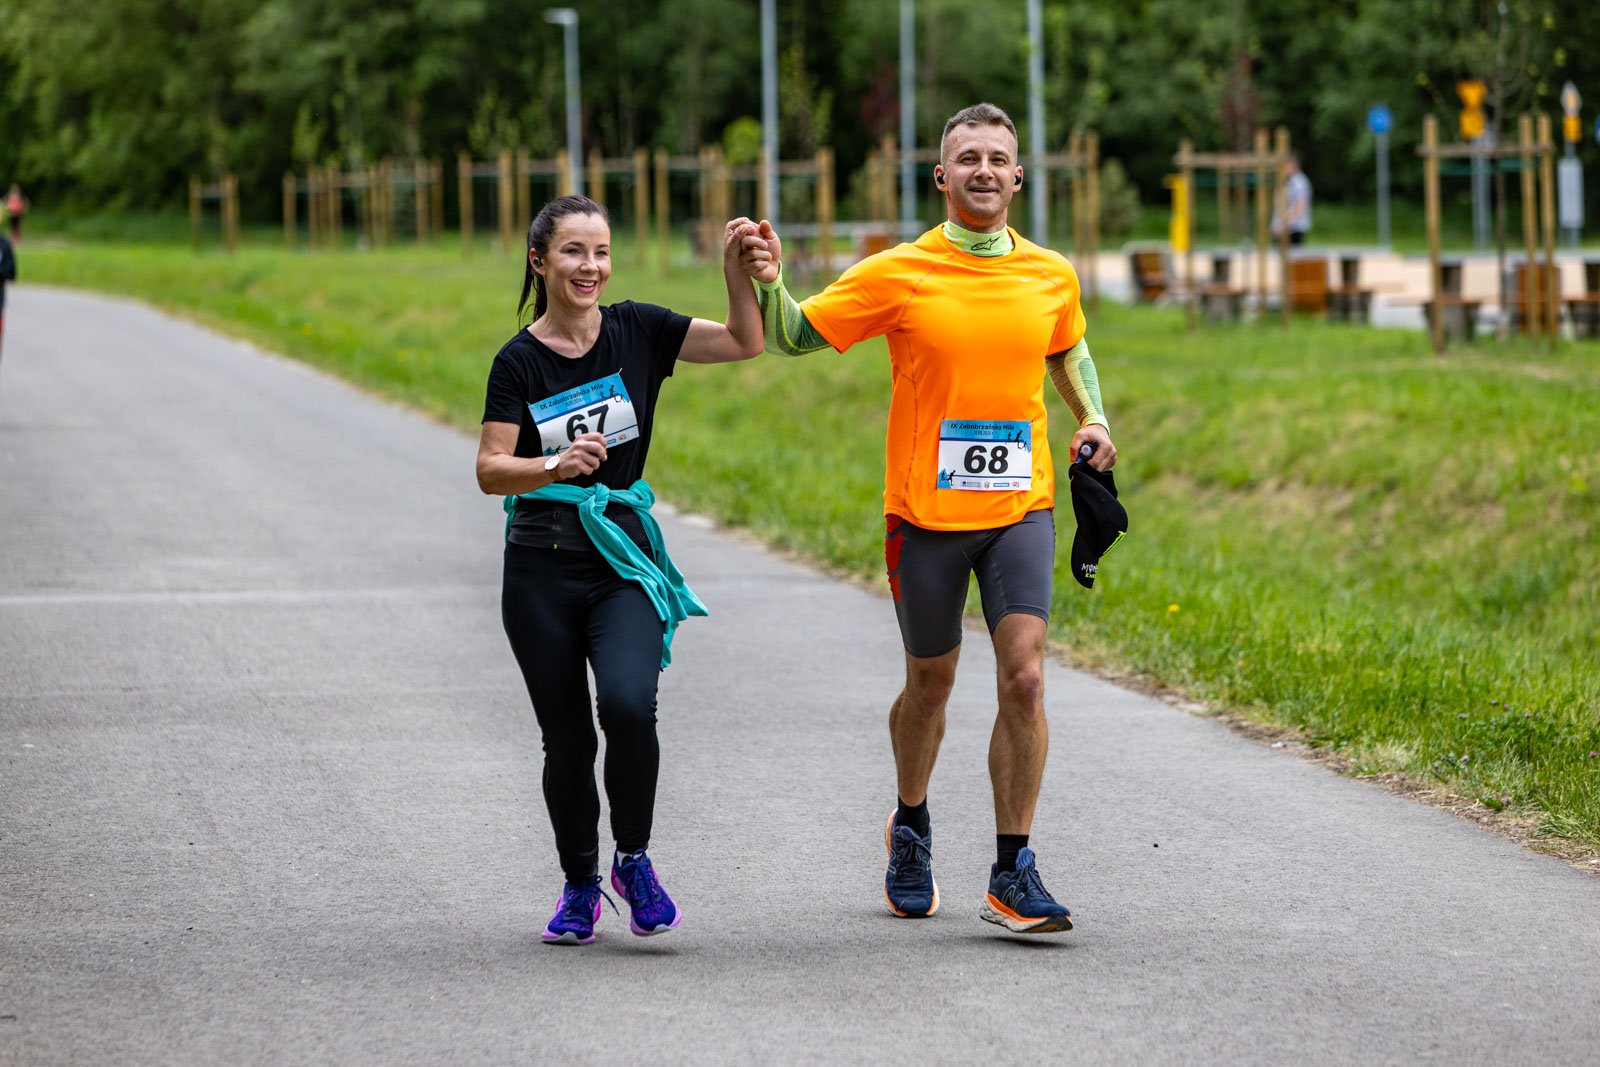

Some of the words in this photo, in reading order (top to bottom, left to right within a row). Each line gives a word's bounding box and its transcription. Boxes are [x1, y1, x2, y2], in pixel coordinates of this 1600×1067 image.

[540, 402, 549, 411] IX
[591, 383, 604, 392] Mila
[566, 404, 610, 443] 67
[963, 445, 1009, 475] 68
